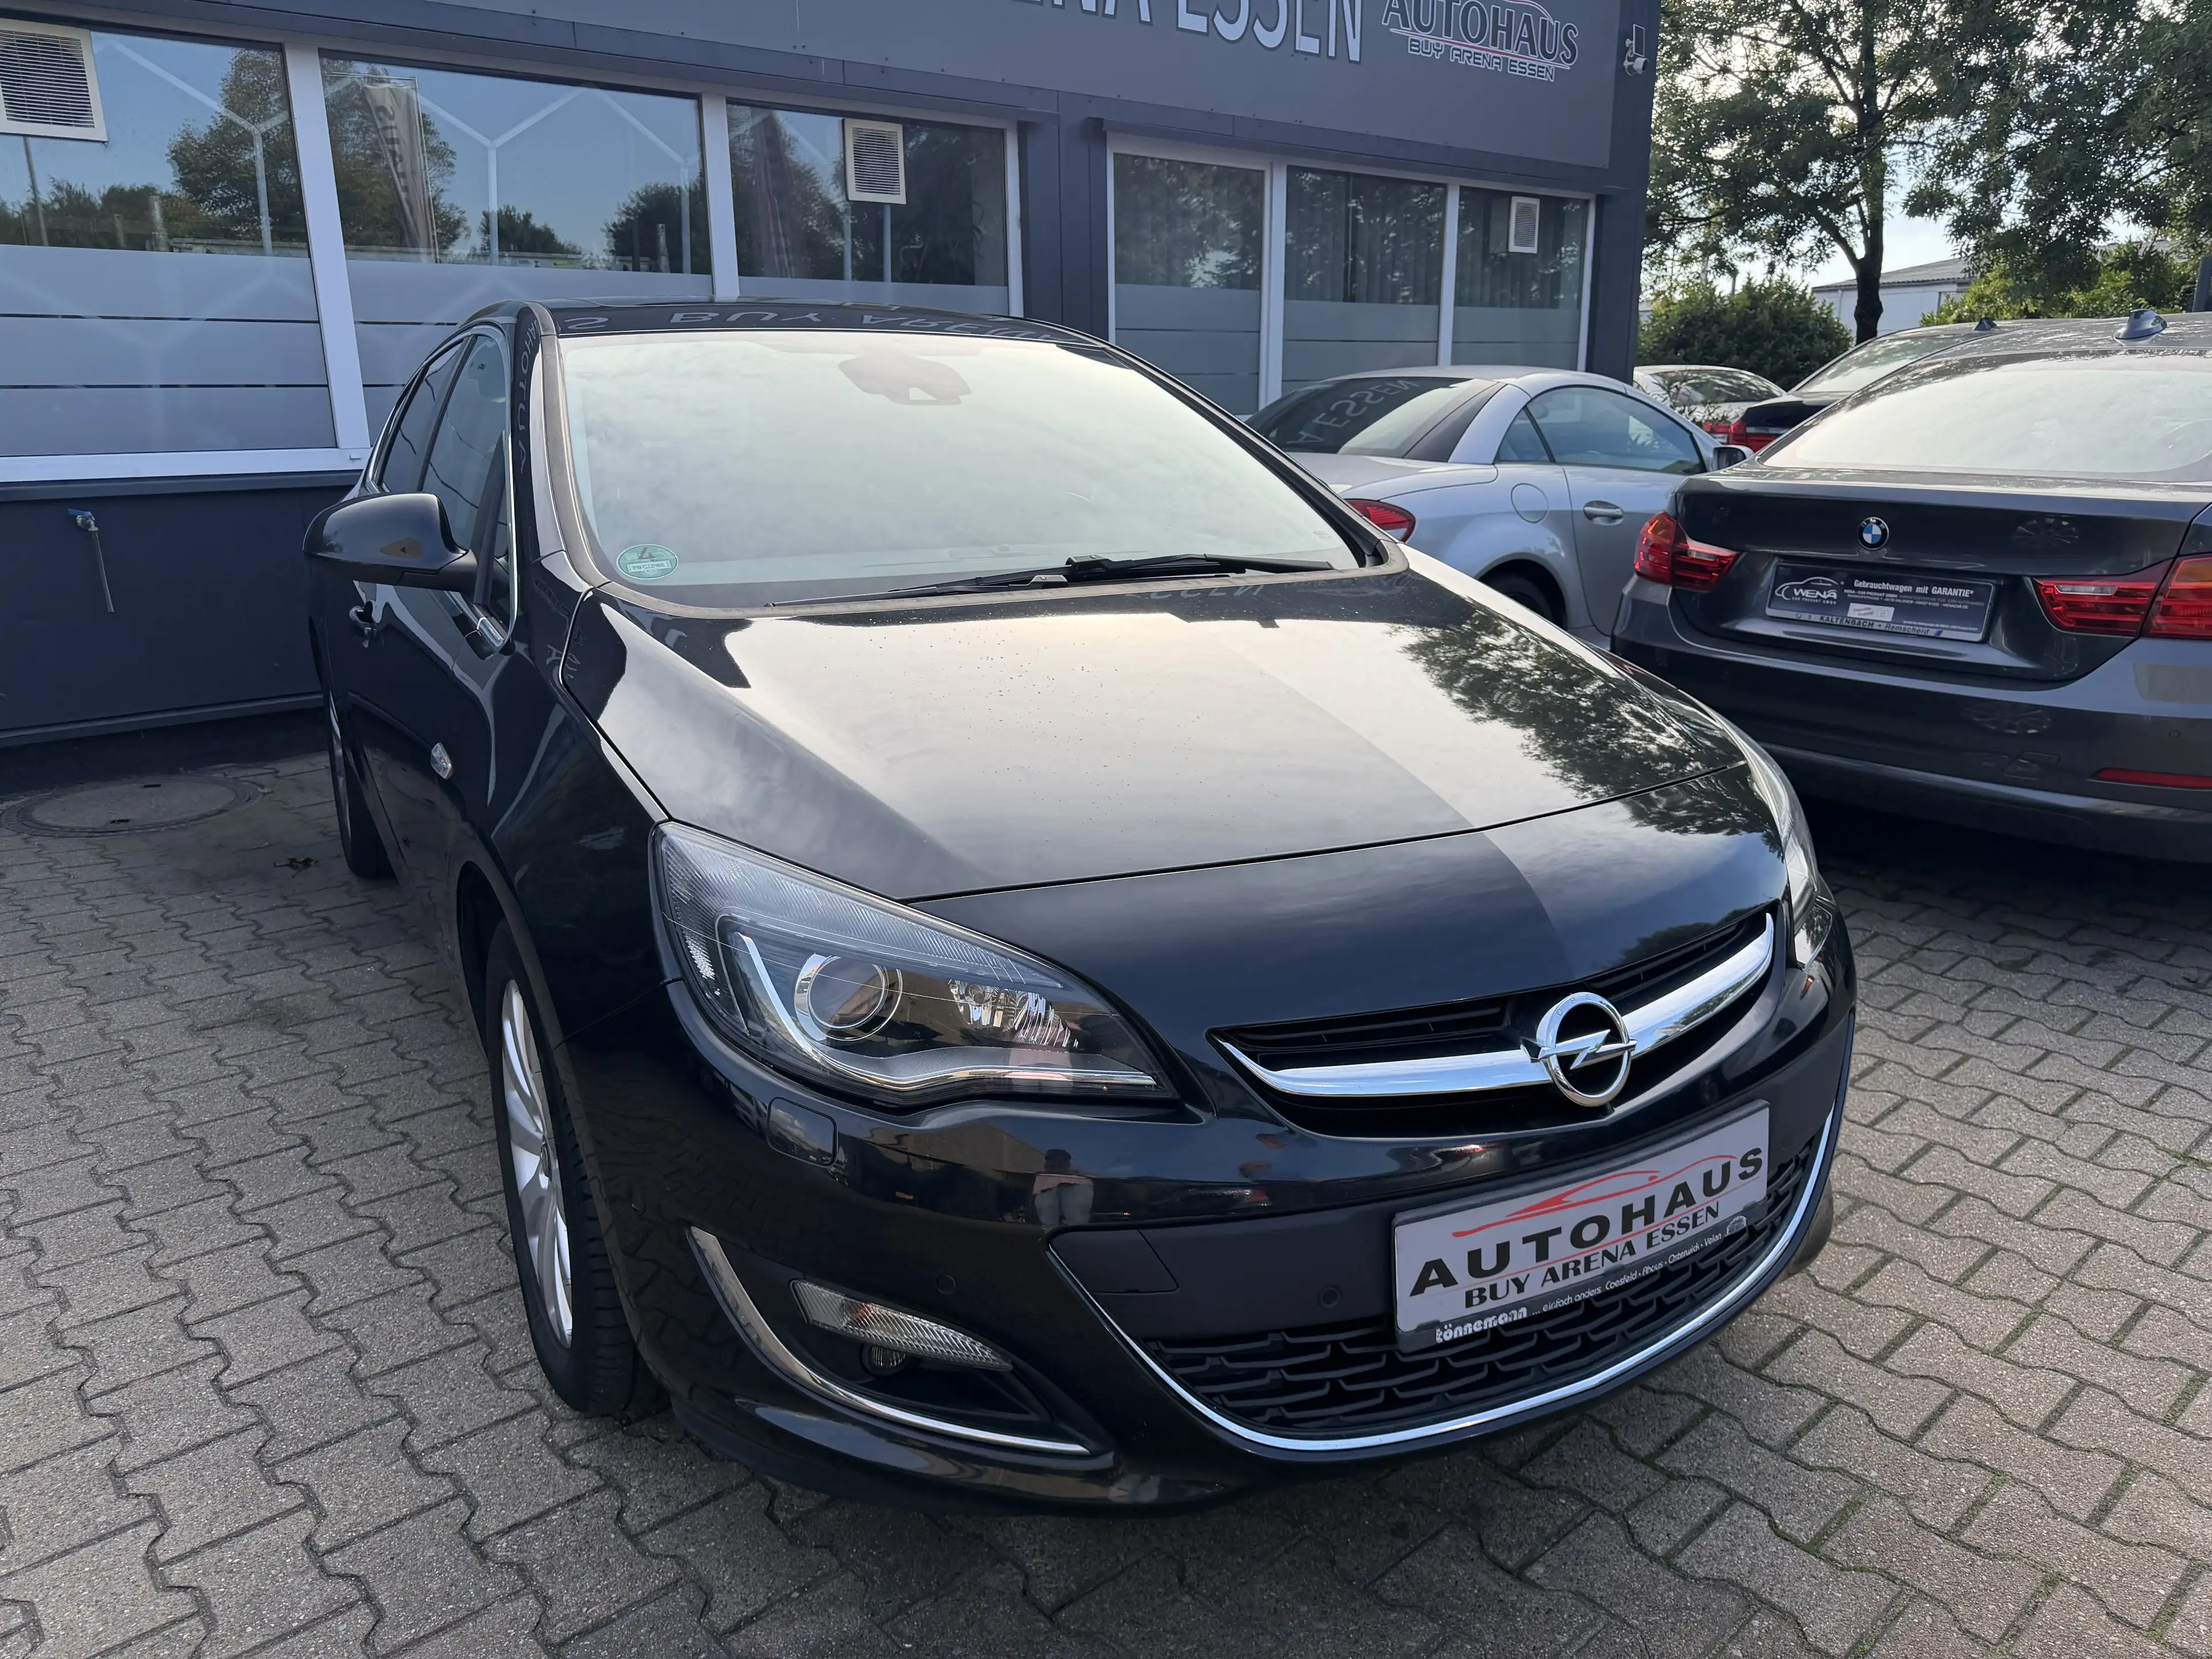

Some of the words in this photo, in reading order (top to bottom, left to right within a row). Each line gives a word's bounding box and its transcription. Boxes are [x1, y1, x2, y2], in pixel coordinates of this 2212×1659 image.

[1381, 0, 1578, 65] AUTOHAUS
[1408, 36, 1445, 59] BUY
[1450, 46, 1502, 71] ARENA
[1508, 59, 1555, 81] ESSEN
[1854, 579, 1912, 593] Gebrauchtwagen
[1819, 615, 1874, 628] KALTENBACH
[1885, 623, 1929, 635] Remscheid
[1409, 1147, 1763, 1297] AUTOHAUS
[1465, 1273, 1530, 1308] BUY
[1541, 1245, 1636, 1287] ARENA
[1646, 1201, 1719, 1251] ESSEN
[1543, 1296, 1573, 1311] einfach
[1574, 1286, 1601, 1302] anders
[1605, 1270, 1637, 1290] Coesfeld
[1668, 1243, 1699, 1264] Osterwick
